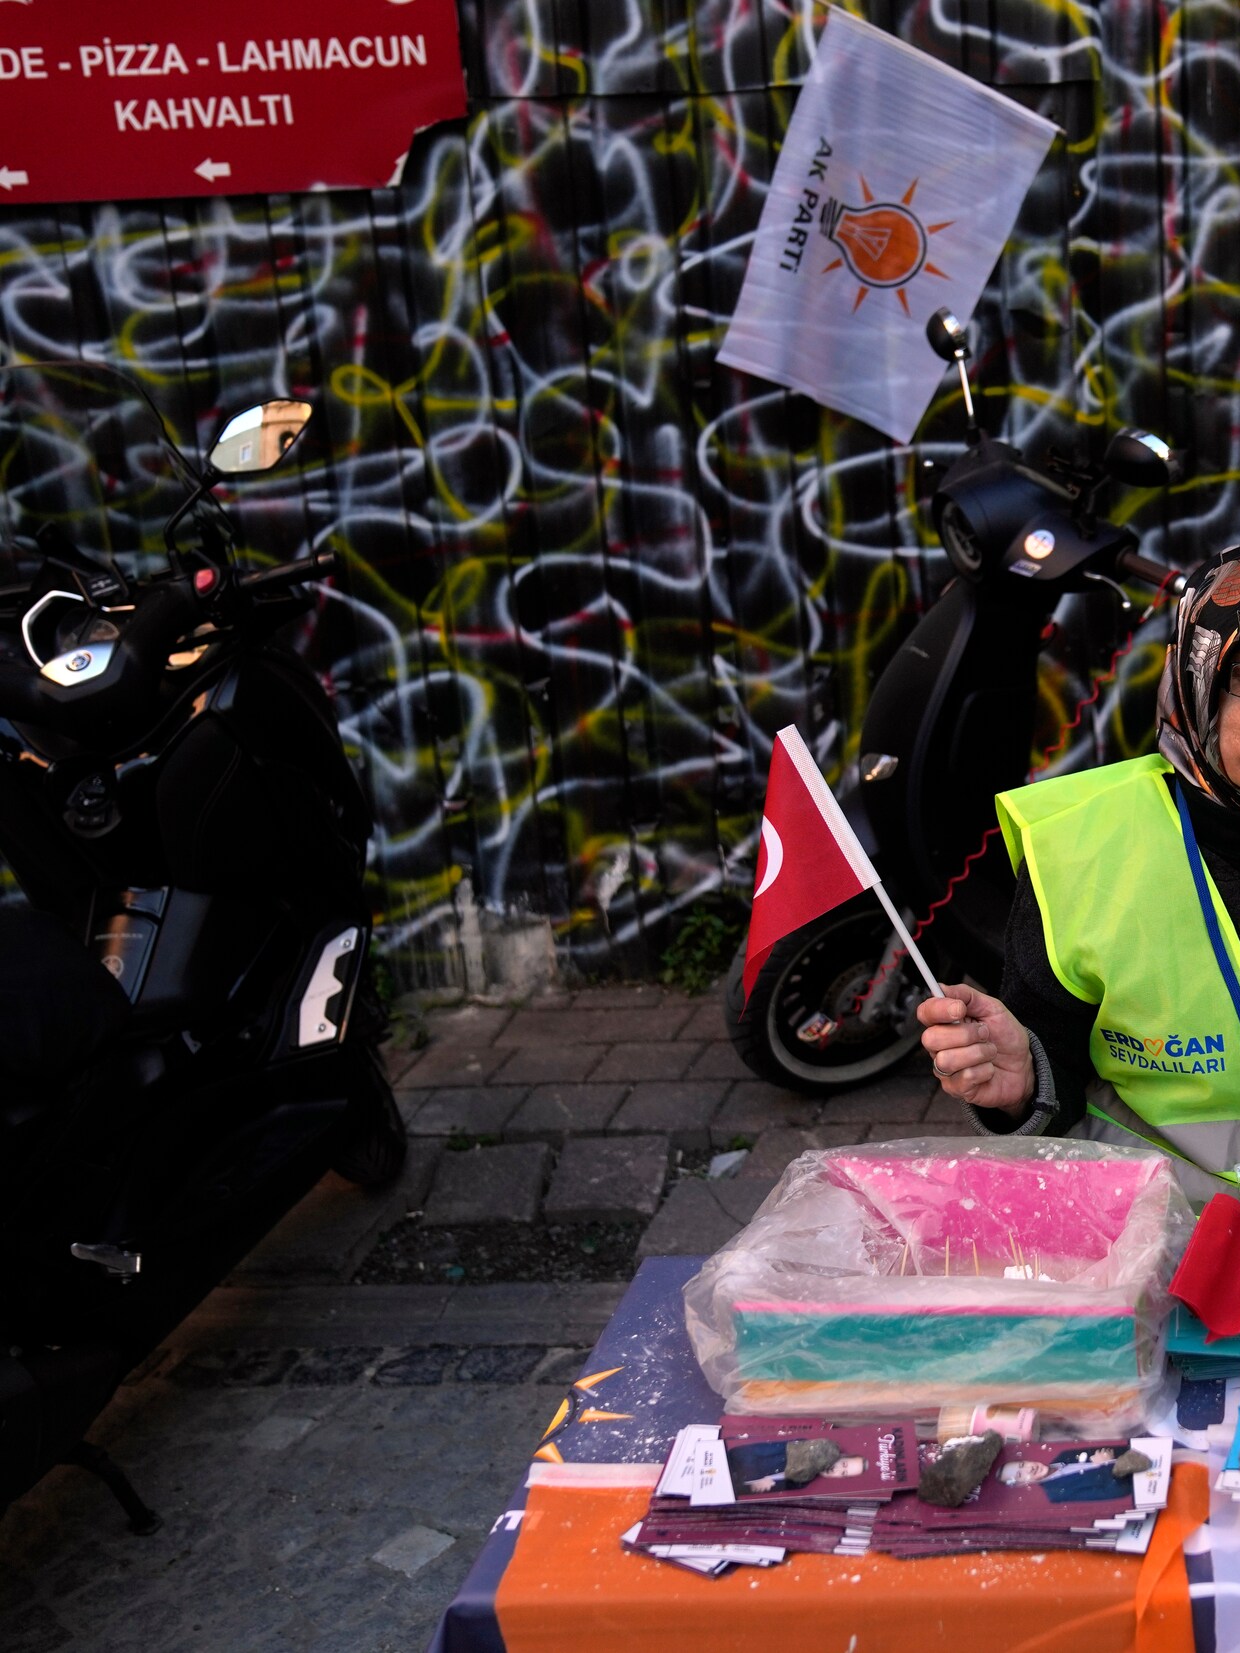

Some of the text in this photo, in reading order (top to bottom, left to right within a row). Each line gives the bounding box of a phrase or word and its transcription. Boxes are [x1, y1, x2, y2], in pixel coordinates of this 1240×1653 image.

[0, 47, 48, 80] DE
[80, 38, 189, 77] PİZZA
[217, 35, 427, 73] LAHMACUN
[114, 94, 294, 131] KAHVALTI
[779, 136, 833, 274] AK PARTİ
[1109, 1044, 1226, 1074] SEVDALILARI
